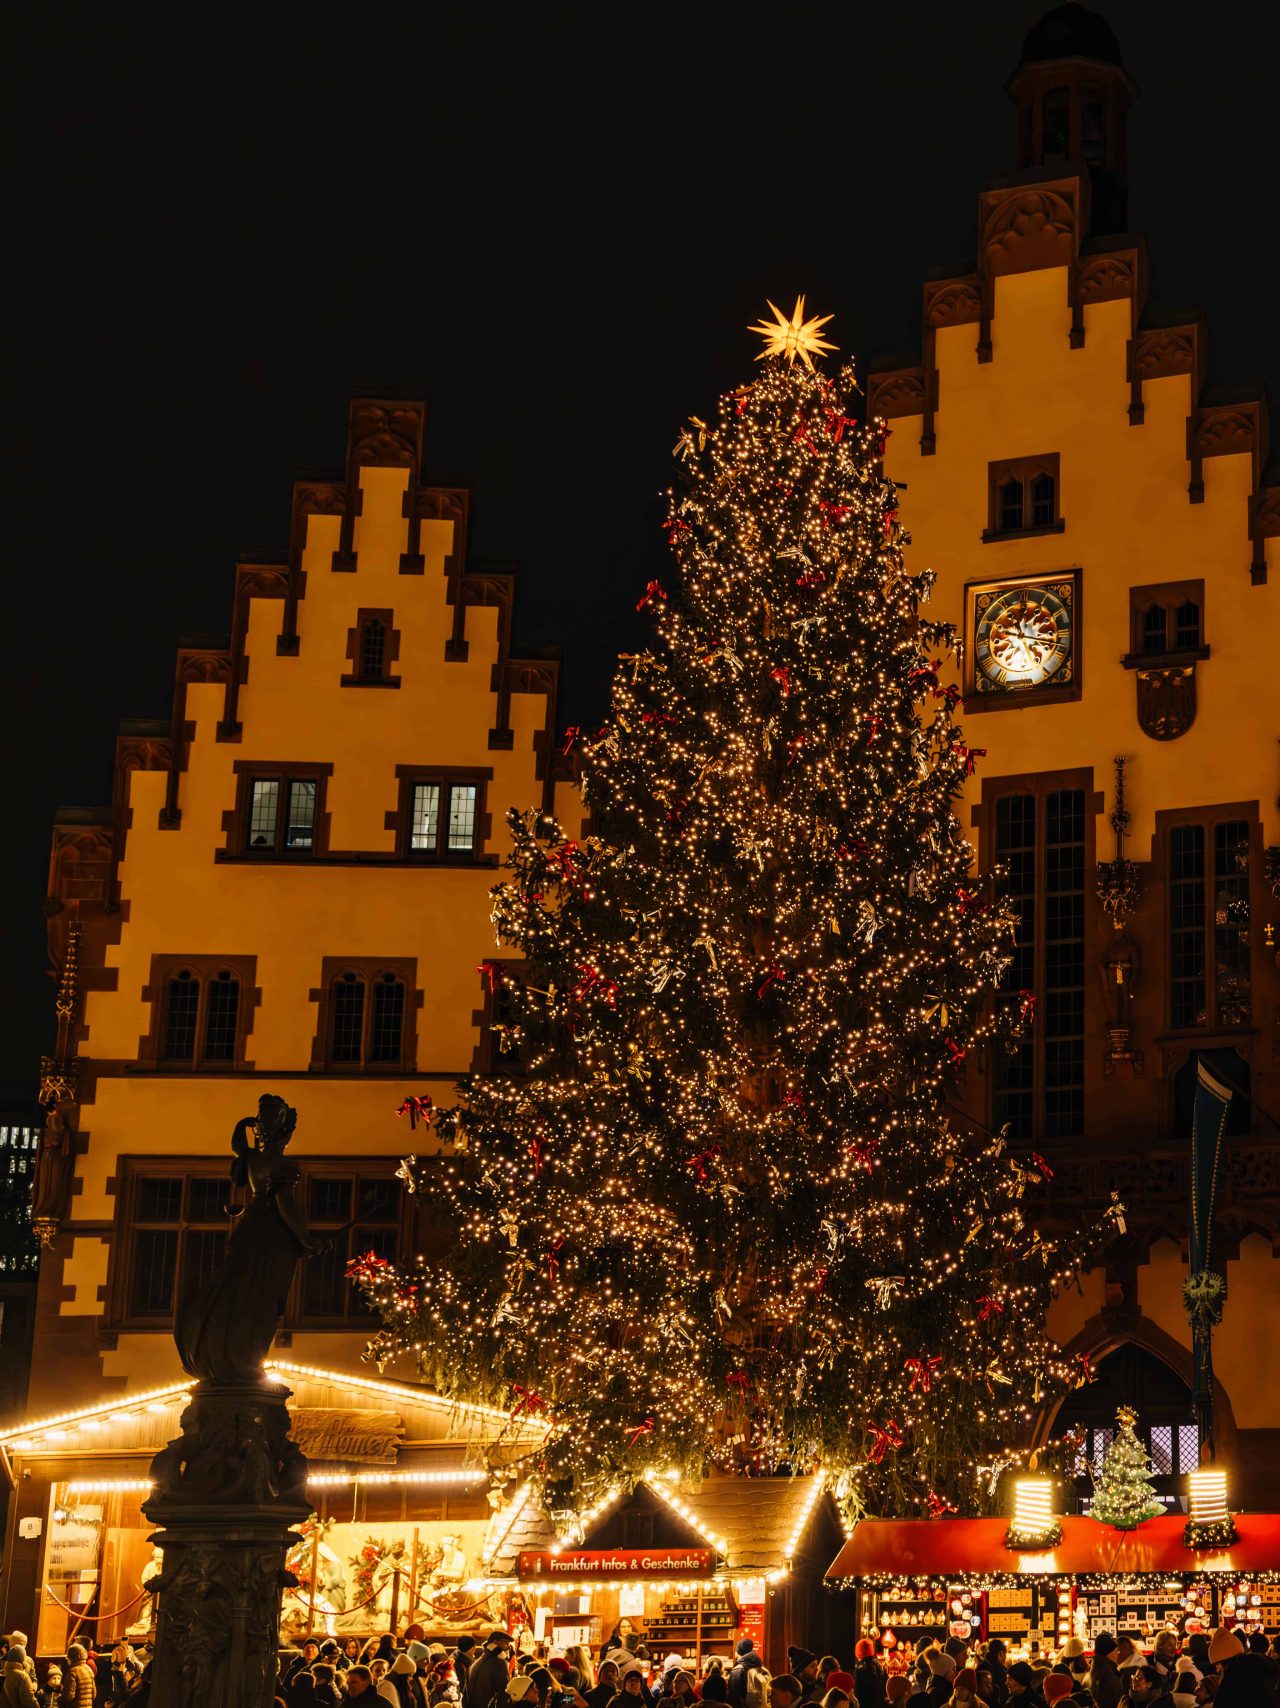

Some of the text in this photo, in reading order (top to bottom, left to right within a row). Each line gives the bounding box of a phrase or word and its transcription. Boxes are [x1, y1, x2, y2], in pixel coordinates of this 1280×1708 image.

[550, 1556, 599, 1572] Frankfurt
[601, 1556, 627, 1570] Infos
[630, 1559, 638, 1570] &
[641, 1555, 700, 1570] Geschenke
